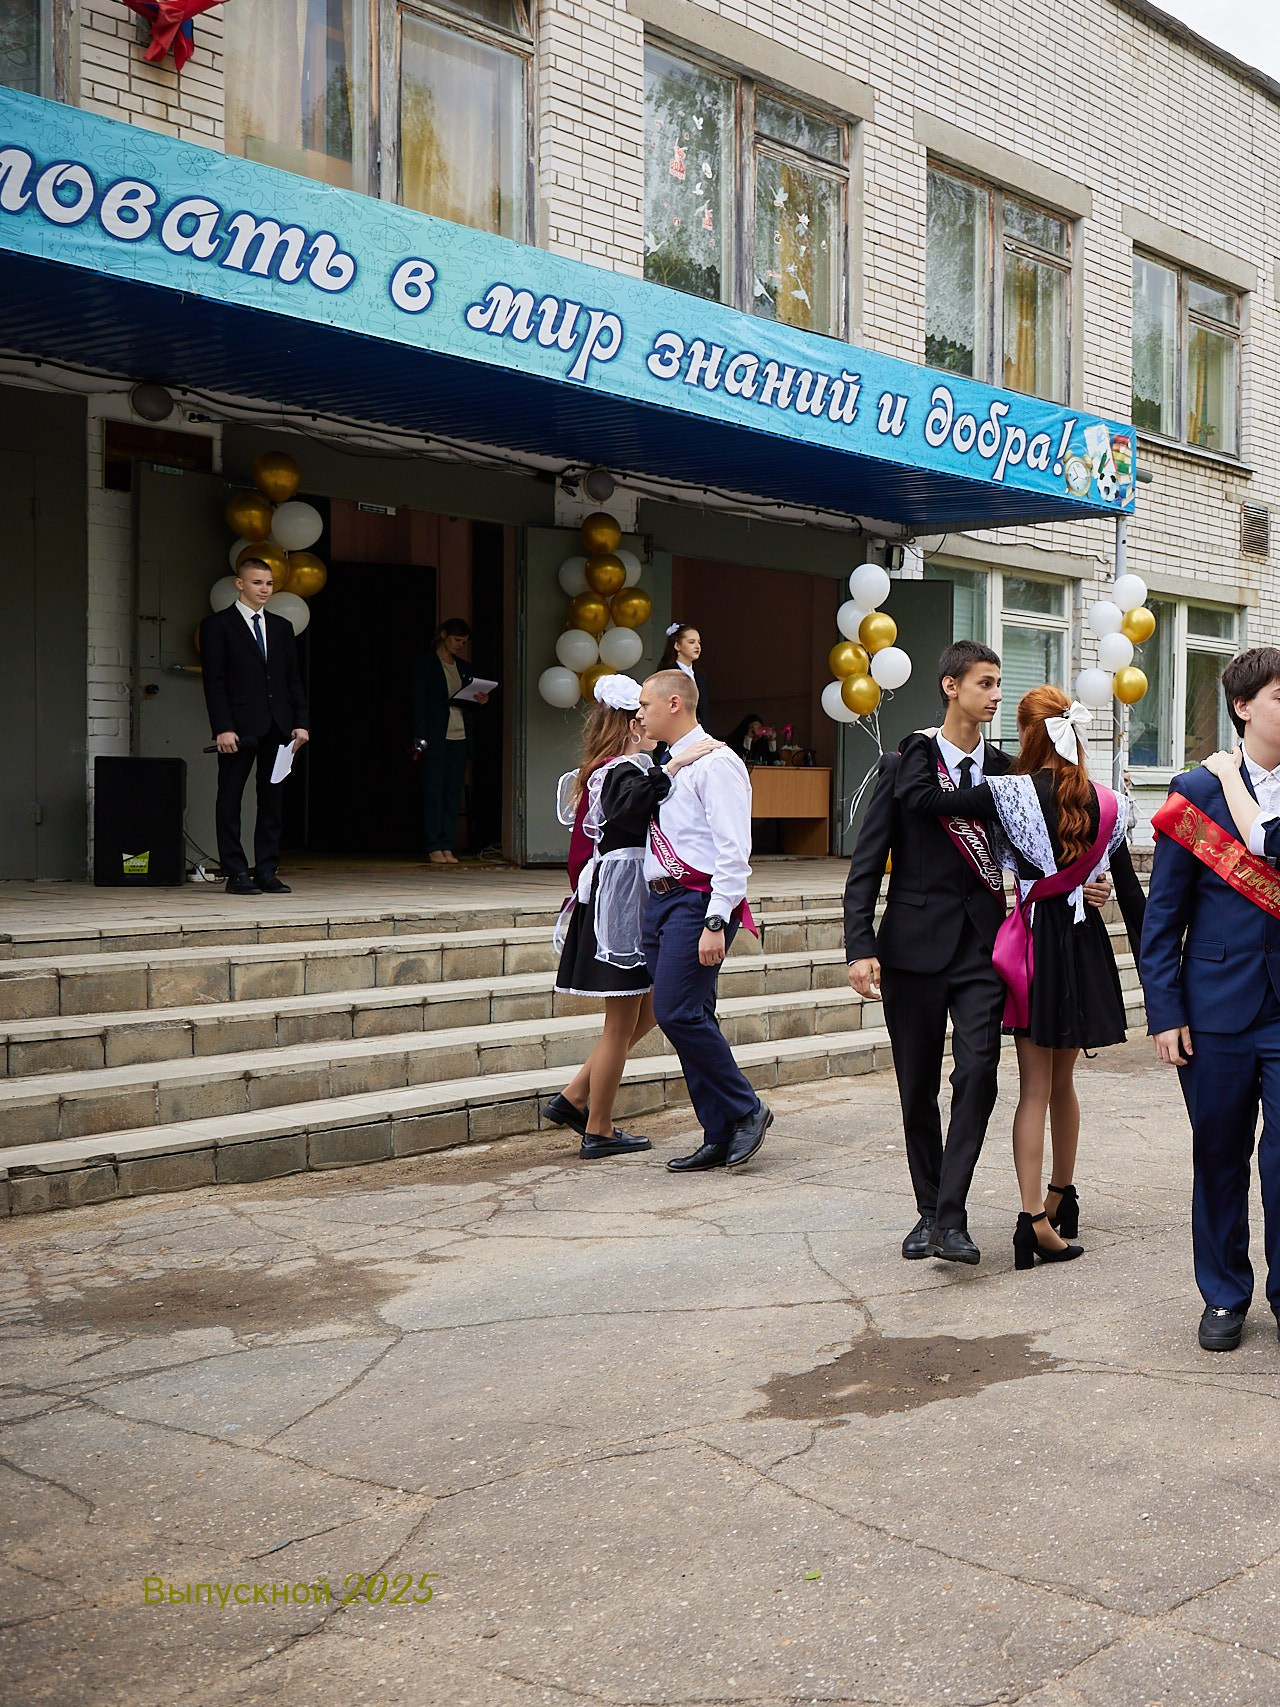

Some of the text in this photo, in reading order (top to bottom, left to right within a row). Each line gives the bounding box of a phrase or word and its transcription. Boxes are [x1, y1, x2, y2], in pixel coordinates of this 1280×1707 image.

[389, 258, 438, 314] в
[464, 282, 622, 382] мир
[646, 331, 862, 425] знаний
[876, 391, 910, 437] и
[924, 383, 1078, 481] добра!
